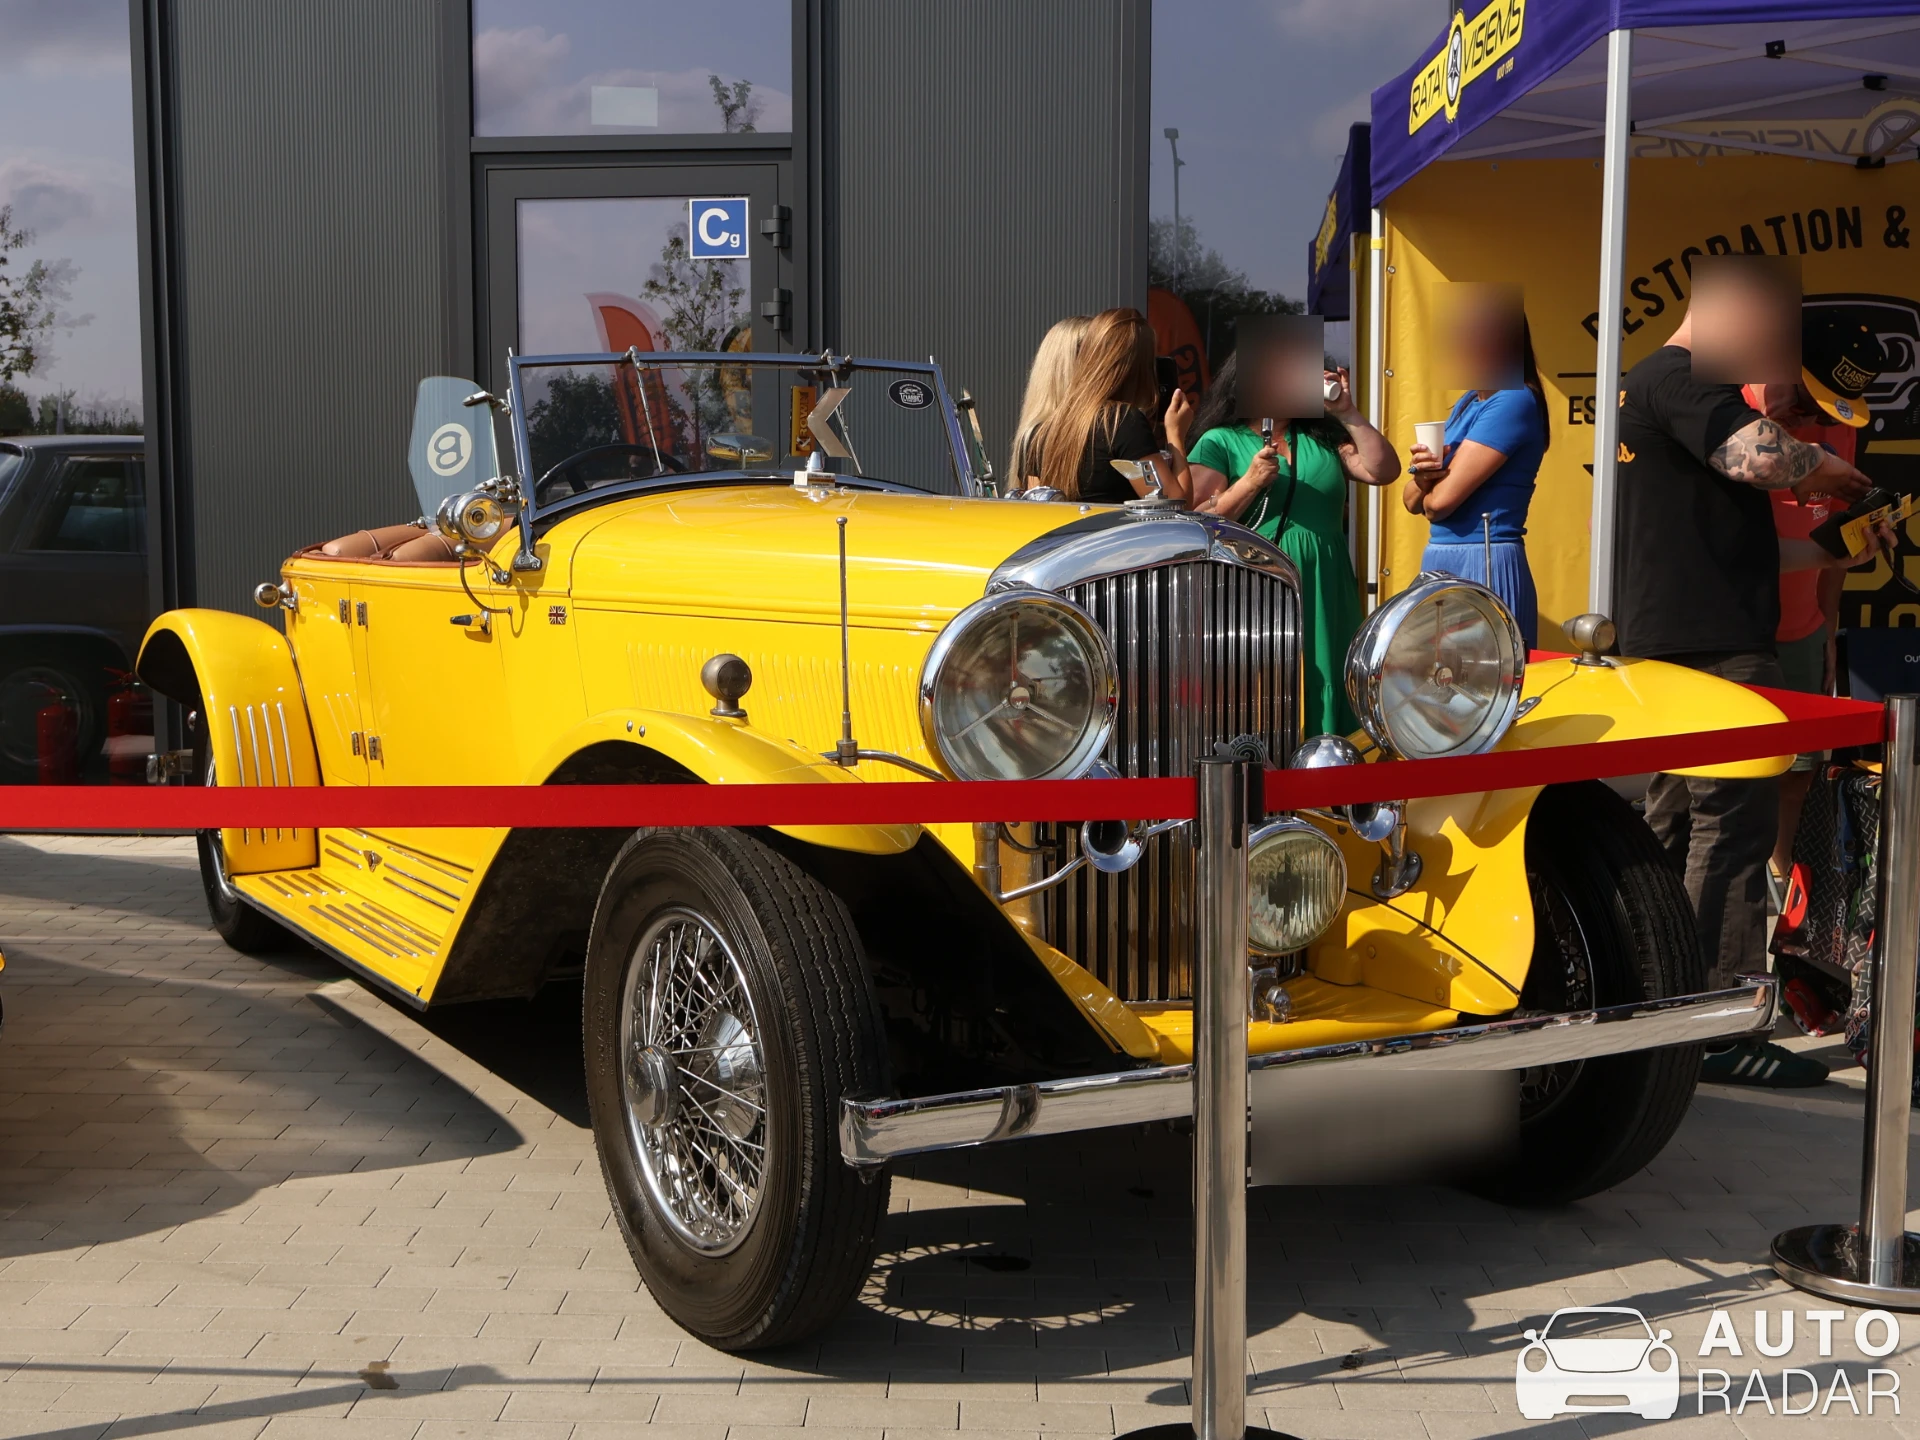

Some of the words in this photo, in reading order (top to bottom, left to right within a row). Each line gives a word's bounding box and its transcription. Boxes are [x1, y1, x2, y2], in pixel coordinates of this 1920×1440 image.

[1411, 57, 1446, 125] RATAI
[1882, 204, 1911, 249] &
[1567, 395, 1596, 426] ES
[1230, 734, 1261, 751] BENTLEY
